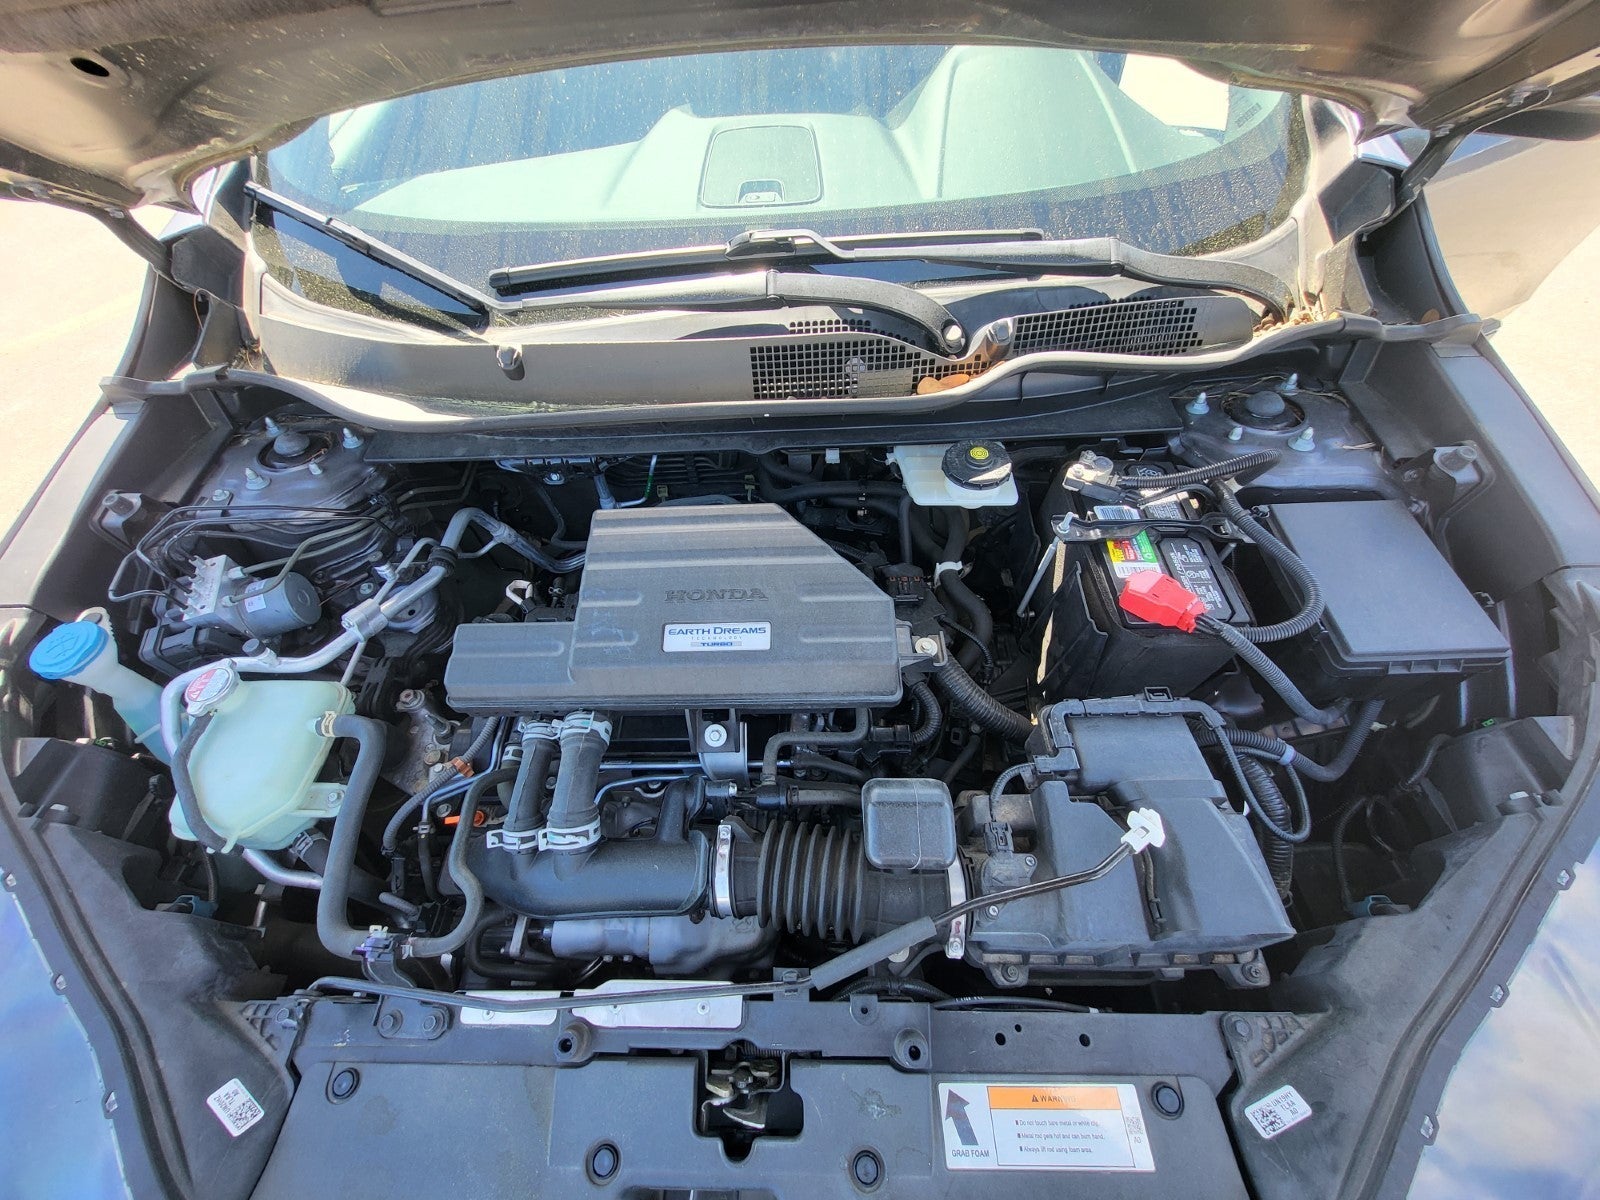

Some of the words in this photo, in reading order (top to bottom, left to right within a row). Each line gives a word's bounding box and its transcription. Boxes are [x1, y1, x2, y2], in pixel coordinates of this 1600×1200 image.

[664, 587, 769, 602] HONDA
[668, 628, 711, 636] EARTH
[713, 626, 767, 635] DREAMS
[951, 1149, 970, 1158] GRAB
[971, 1149, 990, 1159] FOAM
[1024, 1145, 1040, 1154] Always
[1056, 1146, 1068, 1154] using
